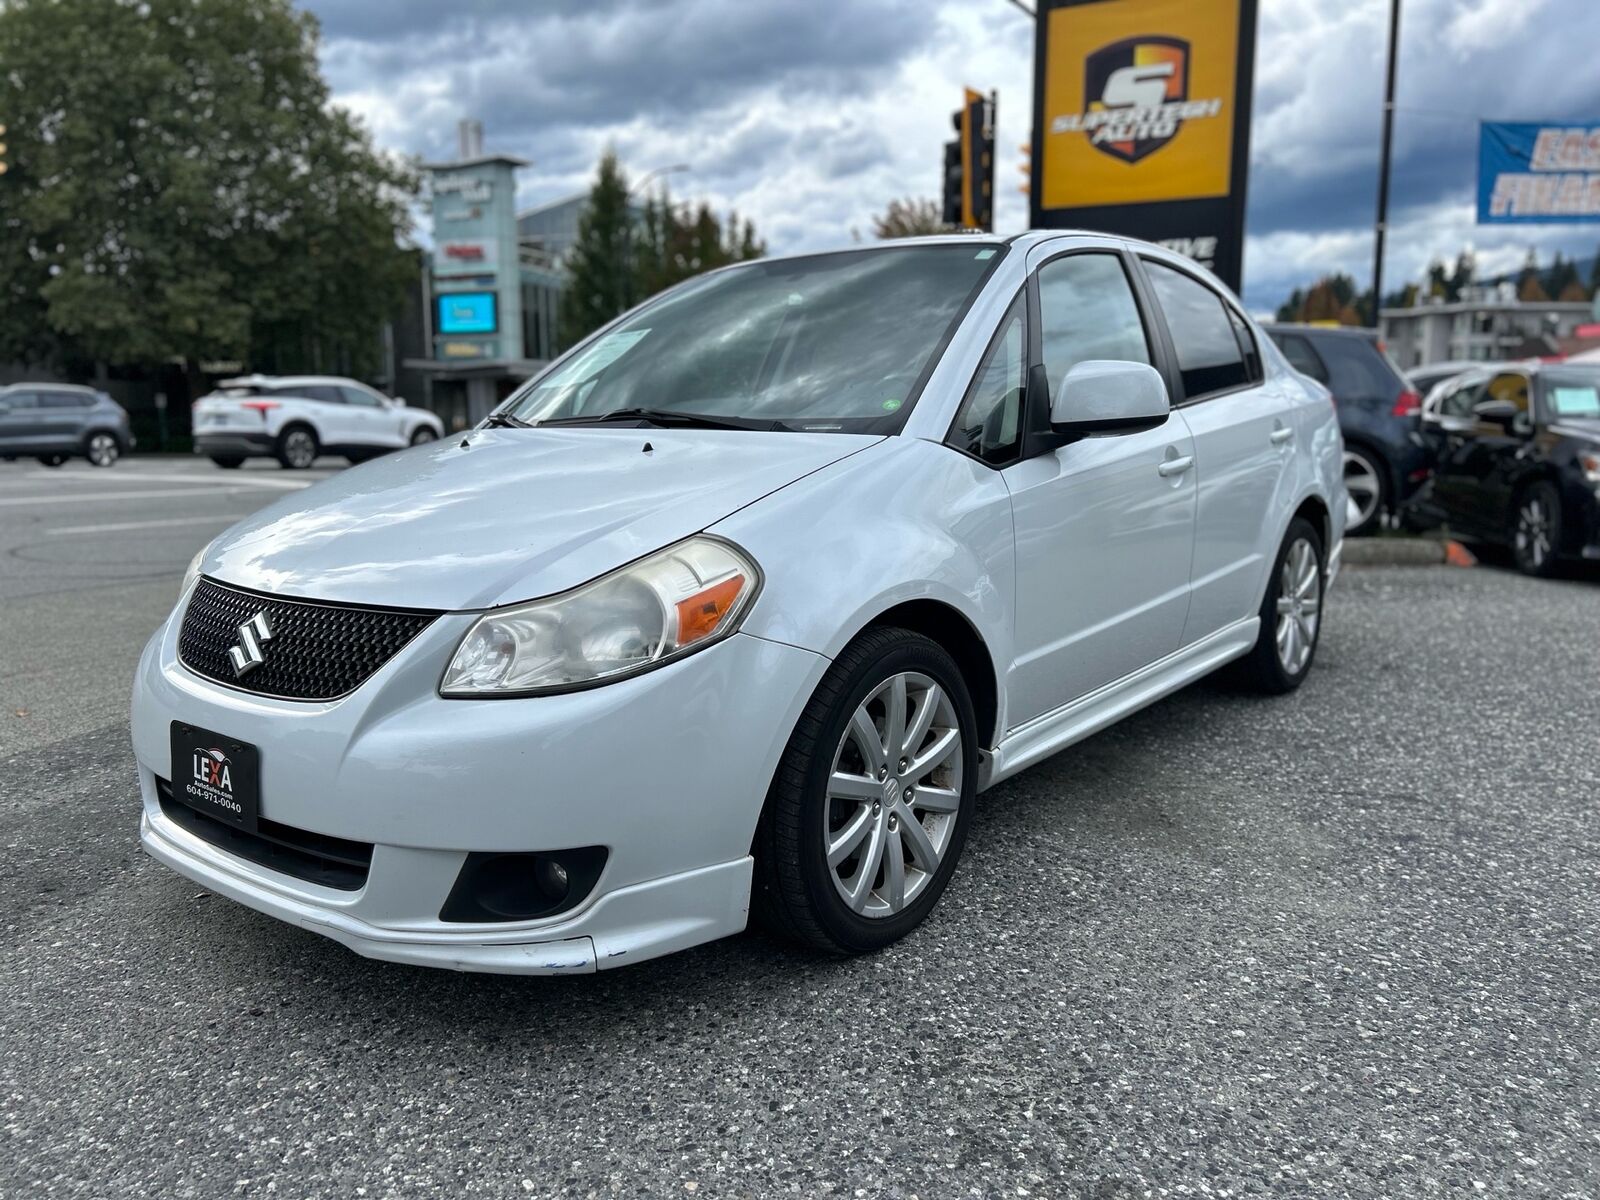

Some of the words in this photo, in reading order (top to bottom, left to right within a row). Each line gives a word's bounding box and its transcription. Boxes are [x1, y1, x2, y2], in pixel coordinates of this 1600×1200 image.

[1092, 121, 1178, 145] AUTO
[193, 754, 233, 792] LEXA
[186, 784, 242, 813] 604-971-0040
[194, 780, 233, 800] AutoSales.com
